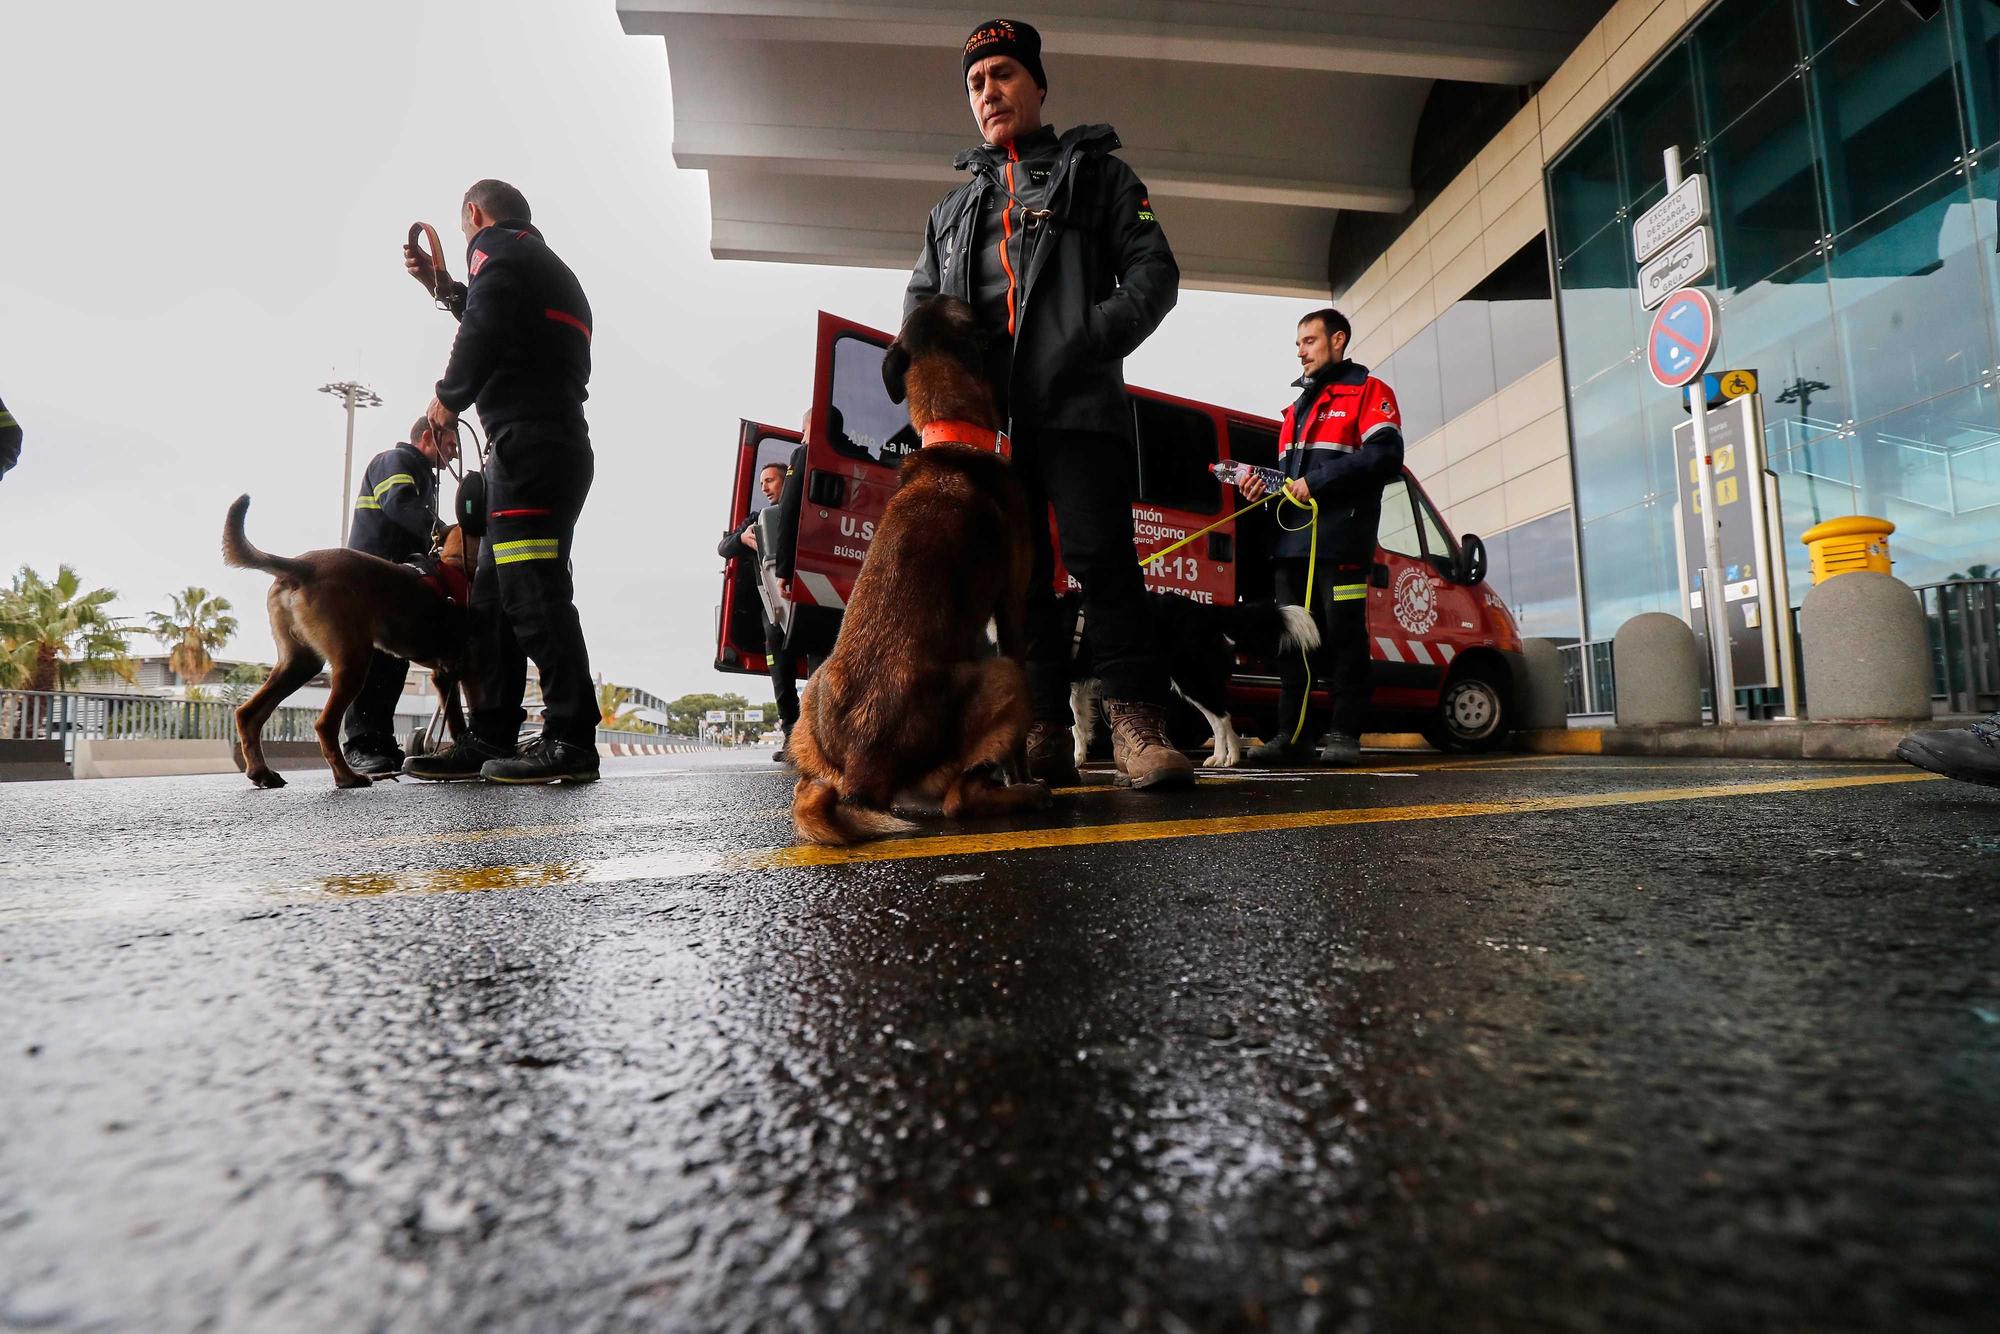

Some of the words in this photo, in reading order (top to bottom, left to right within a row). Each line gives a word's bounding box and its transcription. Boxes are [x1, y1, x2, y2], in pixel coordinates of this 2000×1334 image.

[1647, 203, 1687, 237] DESCARGA
[1649, 194, 1682, 224] EXCEPTO
[1641, 240, 1651, 253] DE
[1653, 208, 1697, 245] PASAJEROS
[883, 438, 897, 453] La
[1133, 520, 1186, 540] lcoyana
[1743, 564, 1752, 578] 2
